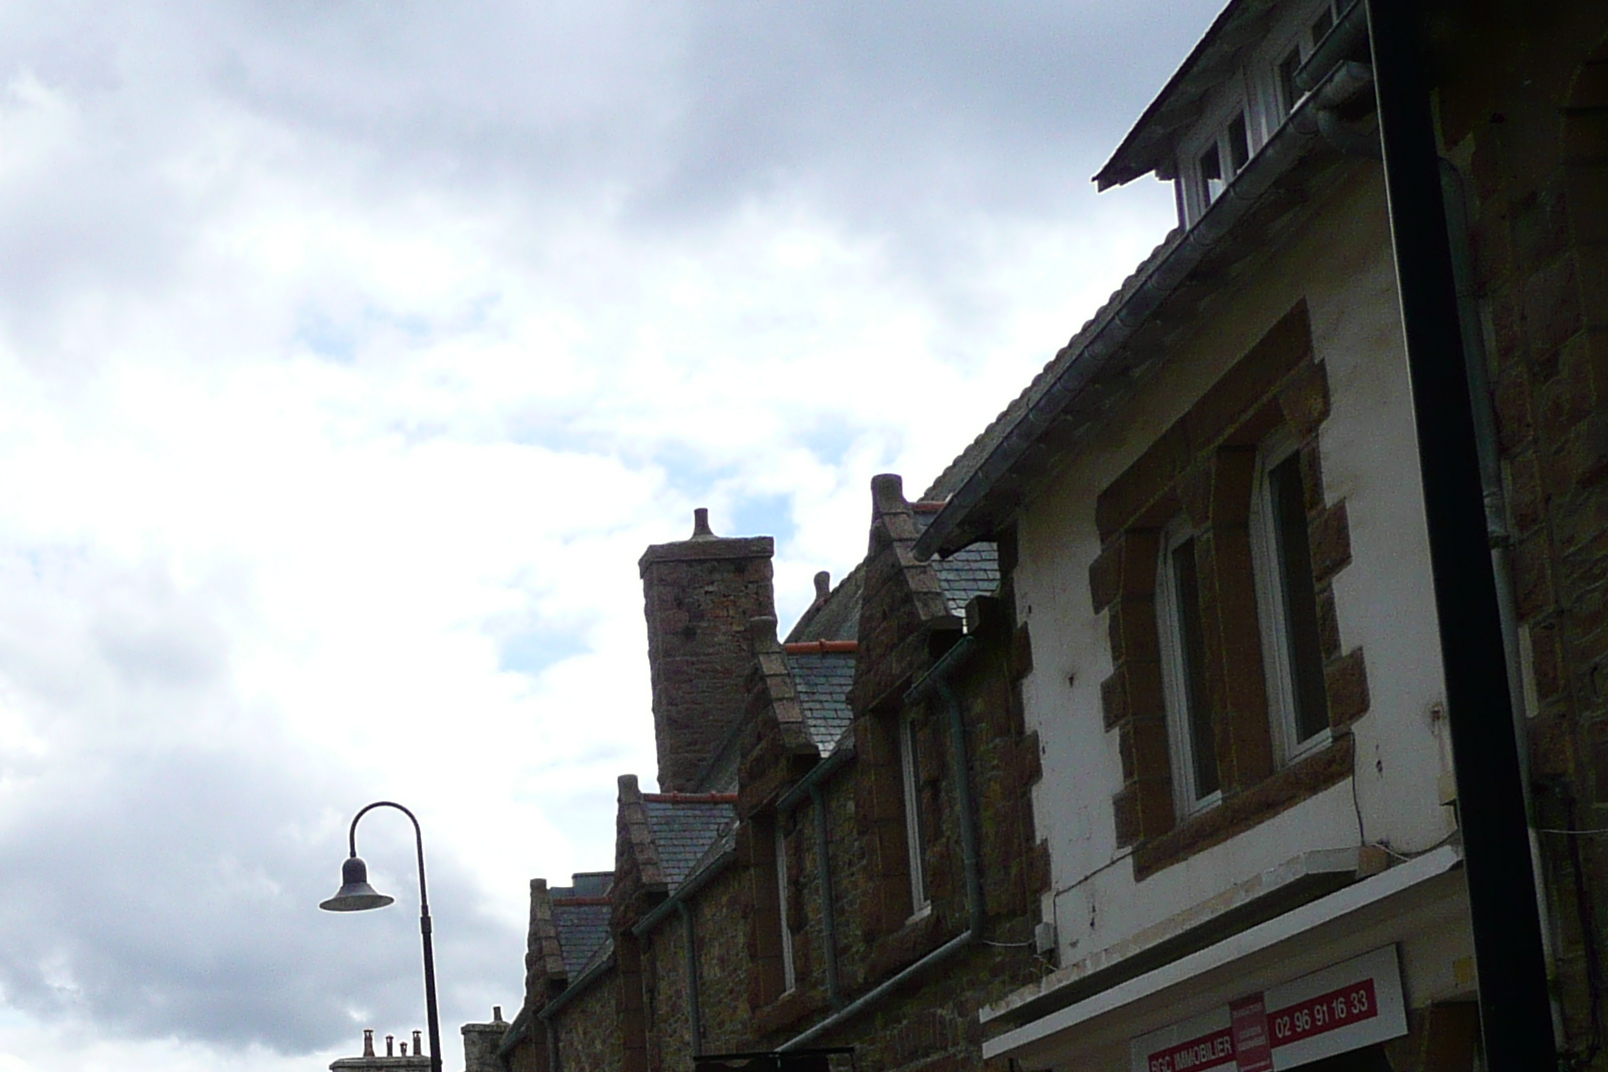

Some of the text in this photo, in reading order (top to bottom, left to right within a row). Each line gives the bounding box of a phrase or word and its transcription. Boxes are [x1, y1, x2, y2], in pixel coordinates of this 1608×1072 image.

[1174, 1036, 1233, 1071] IMMOBILIER
[1275, 1018, 1291, 1038] 02
[1294, 1012, 1311, 1033] 96
[1314, 1004, 1329, 1025] 91
[1332, 998, 1347, 1019] 16
[1350, 990, 1368, 1014] 33
